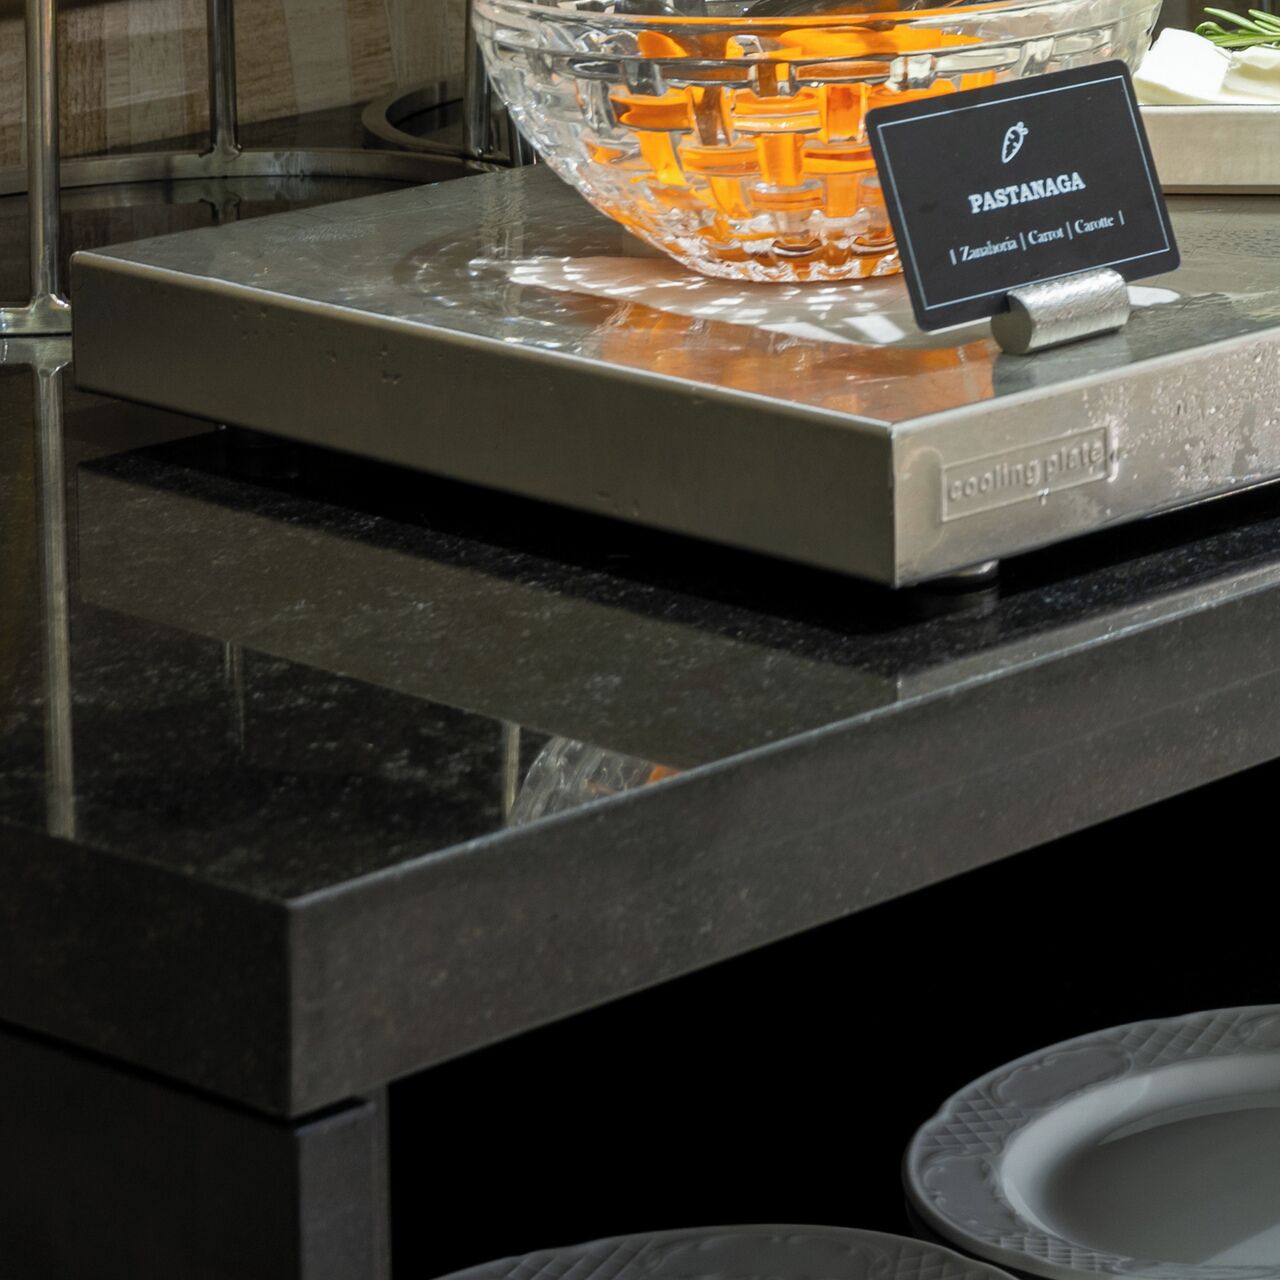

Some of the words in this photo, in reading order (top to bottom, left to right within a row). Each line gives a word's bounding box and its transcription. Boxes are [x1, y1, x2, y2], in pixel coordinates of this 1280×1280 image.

[968, 172, 1086, 214] PASTANAGA
[959, 238, 1018, 262] Zanahoria
[1027, 227, 1064, 246] Carrot
[1074, 216, 1114, 234] Carotte
[949, 460, 1040, 500] cooling
[1043, 442, 1104, 483] plate
